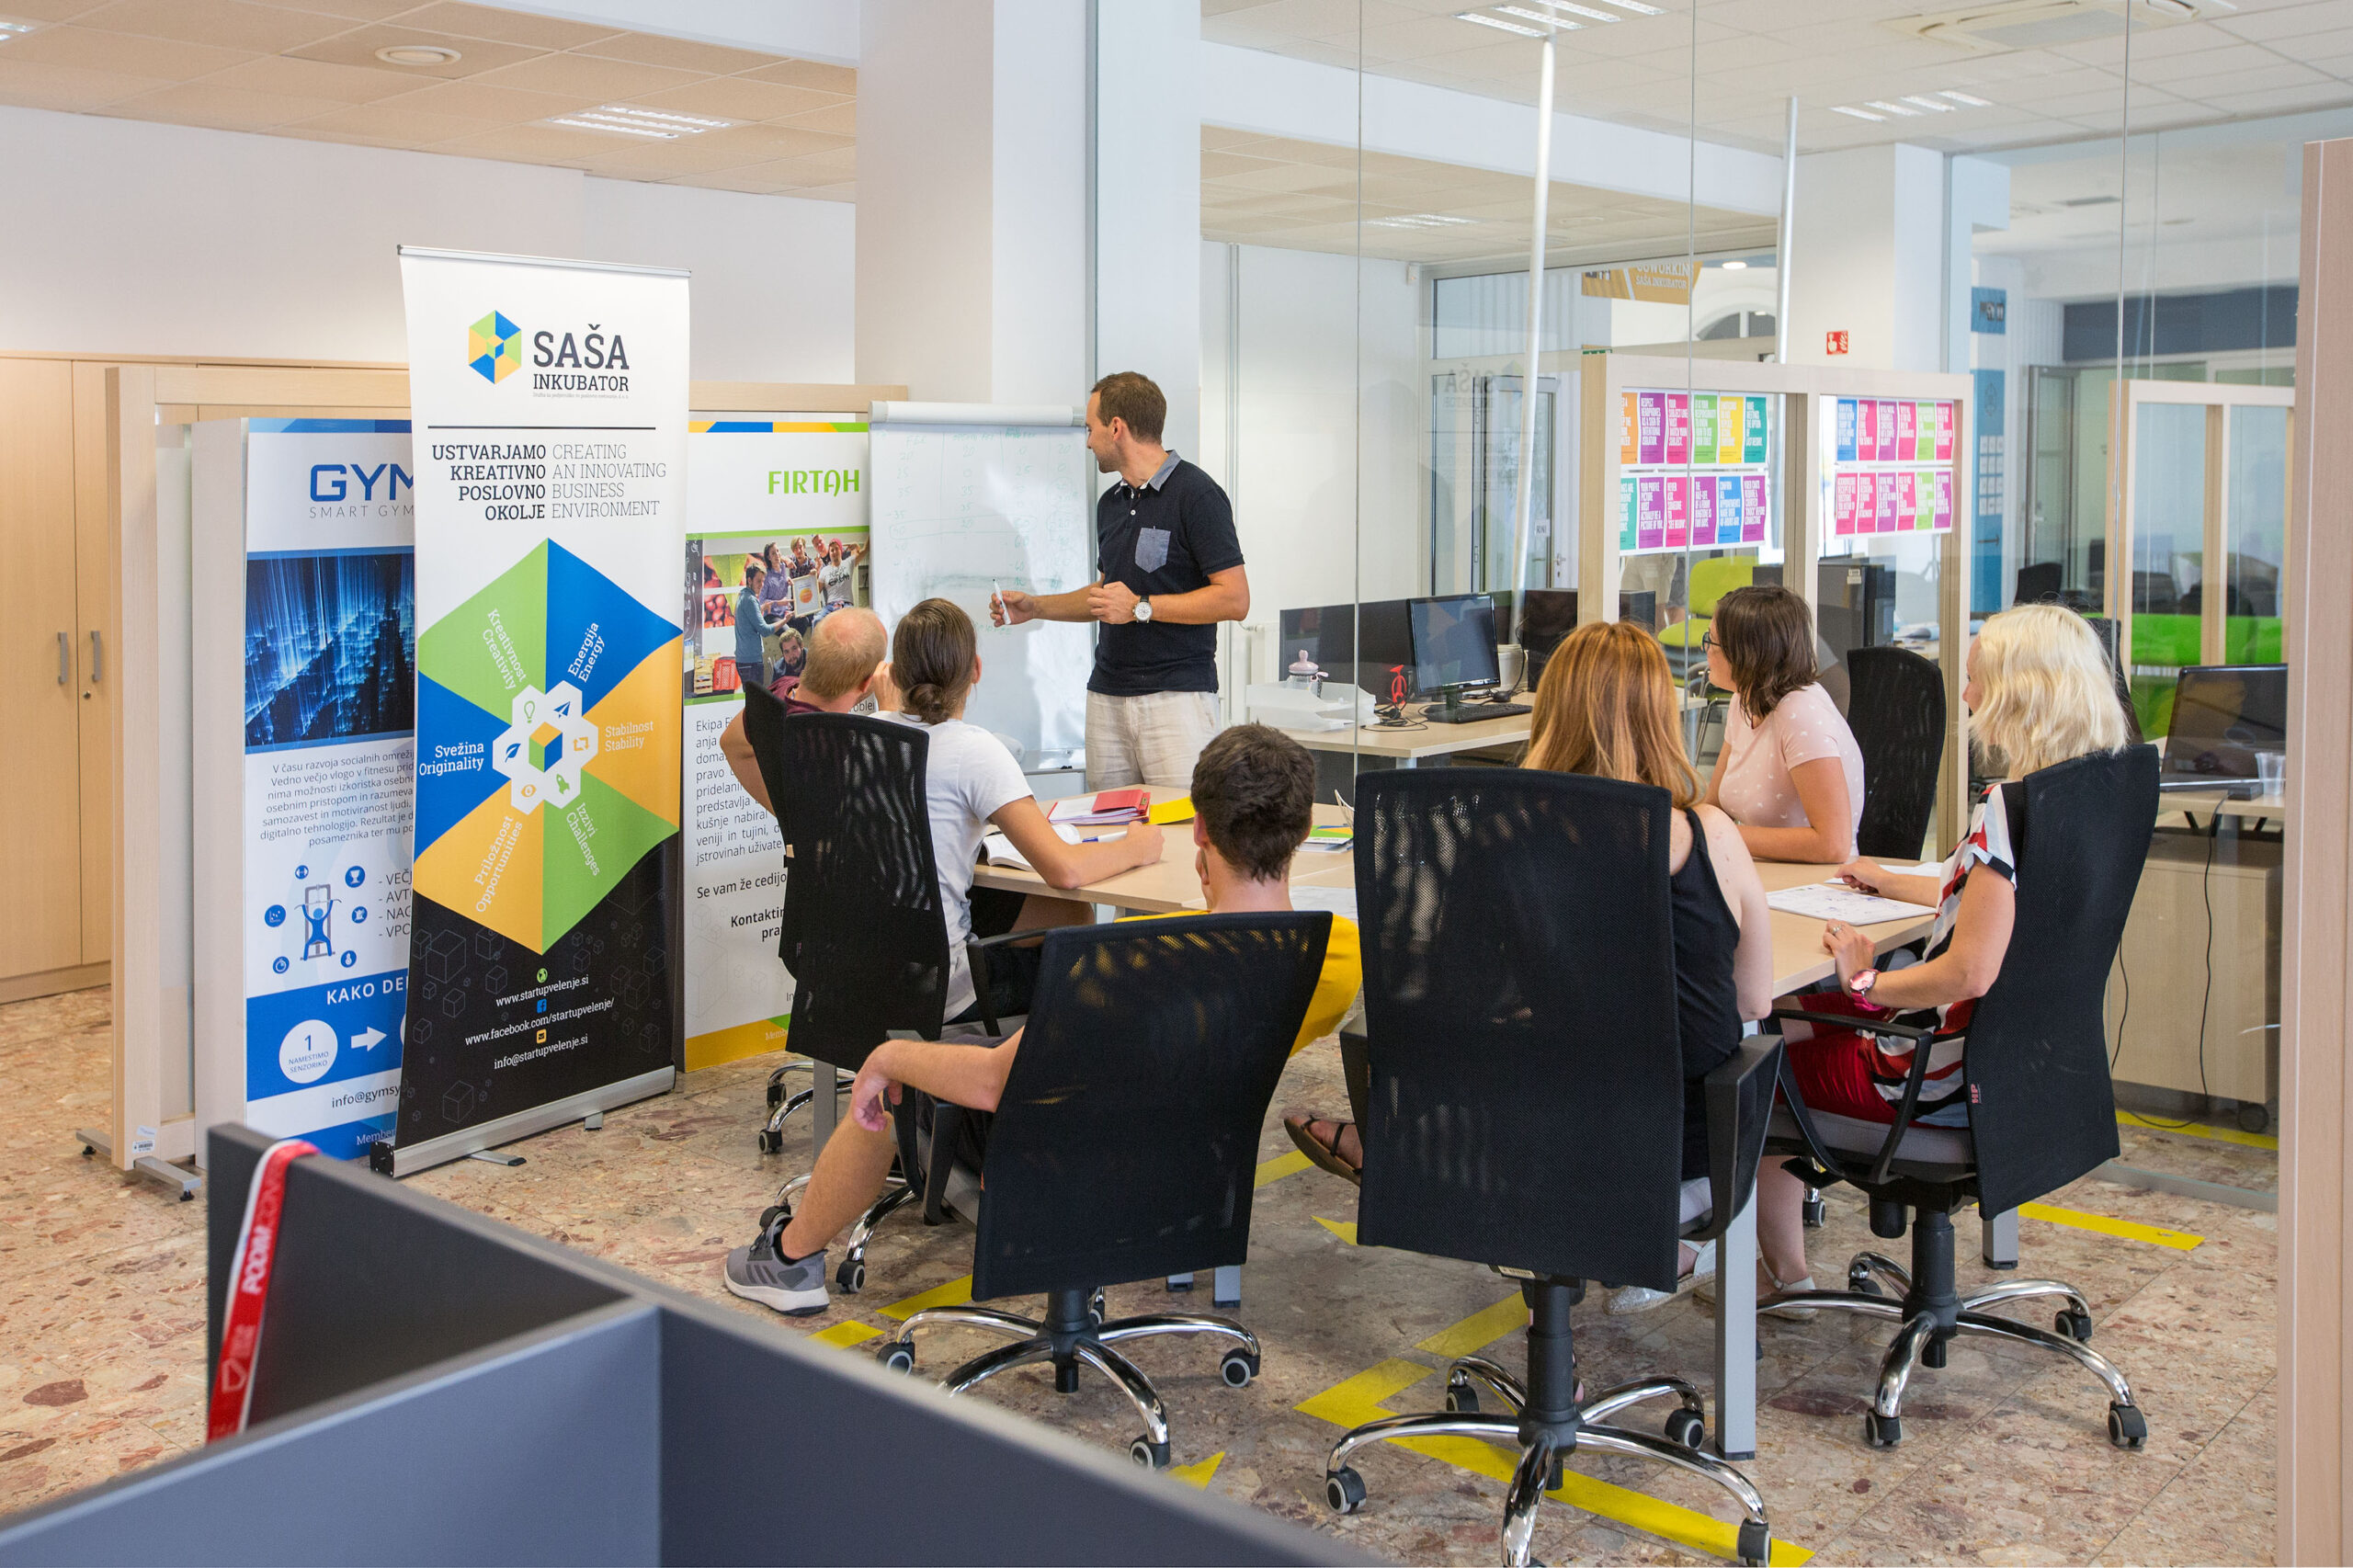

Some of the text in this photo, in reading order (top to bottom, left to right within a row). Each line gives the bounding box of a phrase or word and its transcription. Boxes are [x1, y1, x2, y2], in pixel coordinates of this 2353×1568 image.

[534, 324, 629, 369] SAŠA
[533, 374, 629, 392] INKUBATOR
[432, 445, 546, 460] USTVARJAMO
[552, 444, 627, 460] CREATING
[450, 465, 546, 481] KREATIVNO
[552, 463, 666, 479] AN INNOVATING
[310, 463, 414, 502] GYM
[459, 484, 545, 501] POSLOVNO
[551, 483, 624, 498] BUSINESS
[768, 470, 859, 496] FIRTAH
[310, 505, 414, 518] SMART GYM
[485, 505, 545, 520] OKOLJE
[551, 501, 660, 518] ENVIRONMENT
[488, 608, 527, 683] Kreativnost
[568, 621, 598, 676] Energija
[483, 629, 517, 690] Creativity
[578, 636, 605, 683] Energy
[606, 721, 654, 737] Stabilnost
[696, 720, 722, 733] Ekipa
[435, 742, 484, 758] Svežina
[606, 736, 644, 752] Stability
[696, 737, 717, 749] anja
[273, 764, 279, 774] V
[281, 762, 303, 773] času
[305, 759, 338, 771] razvoja
[341, 754, 380, 766] socialnih
[419, 756, 484, 776] Originality
[696, 753, 727, 765] doma
[271, 776, 301, 787] Vedno
[304, 773, 327, 784] večjo
[330, 769, 355, 780] vlogo
[365, 765, 393, 776] fitnesu
[696, 768, 724, 784] pravo
[267, 790, 291, 801] nima
[294, 785, 337, 796] možnosti
[339, 779, 381, 791] izkoristka
[267, 801, 307, 813] osebnim
[310, 794, 358, 810] pristopom
[360, 793, 368, 801] in
[696, 796, 750, 816] predstavlja
[263, 813, 318, 827] samozavest
[321, 810, 329, 819] in
[332, 802, 388, 817] motiviranost
[578, 802, 597, 837] Izzivi
[696, 815, 729, 831] kušnje
[260, 825, 301, 841] digitalno
[304, 820, 358, 835] tehnologijo.
[360, 813, 396, 826] Rezultat
[397, 813, 406, 823] je
[309, 830, 369, 848] posameznika
[371, 827, 383, 837] ter
[386, 825, 400, 835] mu
[565, 812, 600, 876] Challenges
[696, 832, 722, 846] veniji
[728, 830, 737, 841] in
[474, 815, 514, 886] Priložnost
[696, 845, 745, 867] jstrovinah
[476, 822, 522, 913] Opportunities
[697, 871, 787, 899] Se vam že cedijo
[386, 889, 411, 903] AVT
[761, 927, 782, 942] pra
[327, 976, 408, 1005] KAKO DE
[496, 974, 589, 1007] www.startupvelenje.si
[465, 997, 614, 1046] www.facebook.com/startupvelenje/
[304, 1035, 312, 1051] 1
[494, 1033, 588, 1069] info@startupvelenje.si
[289, 1051, 329, 1065] NAMESTIMO
[290, 1061, 327, 1074] SENZORIKO
